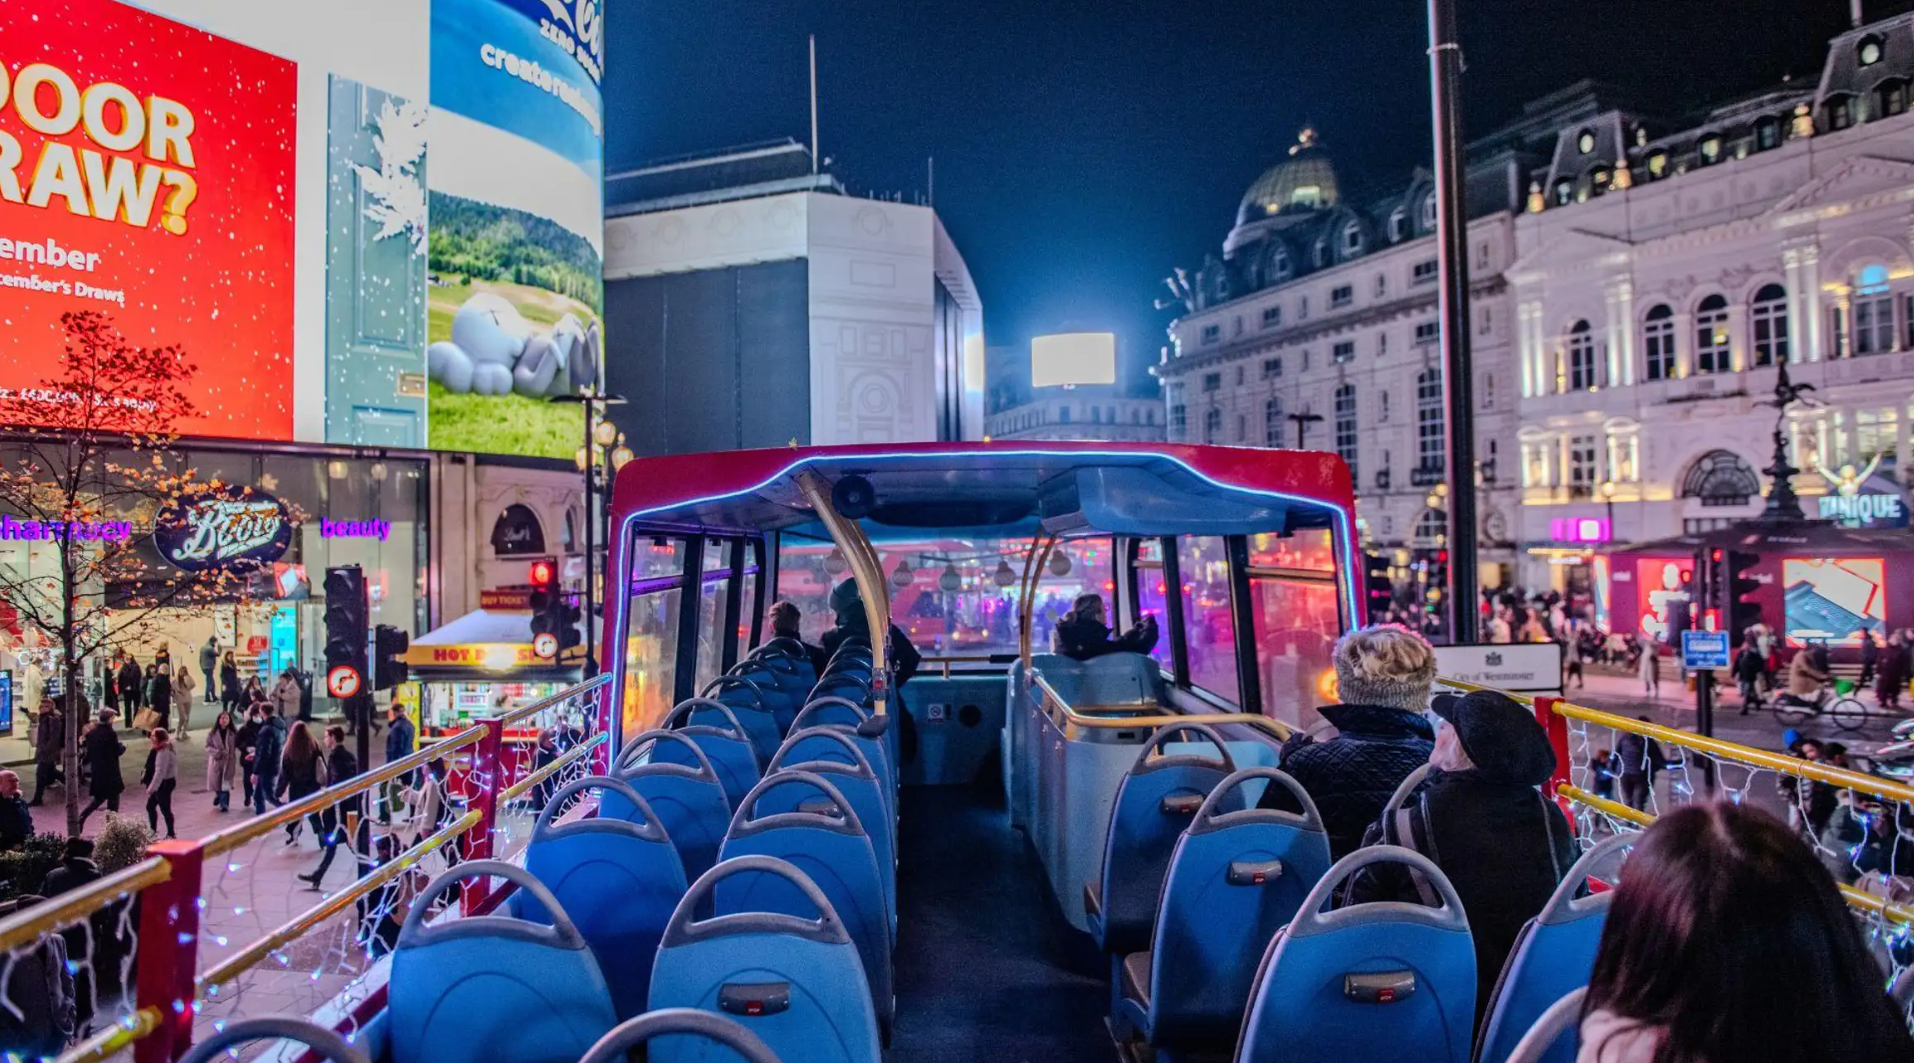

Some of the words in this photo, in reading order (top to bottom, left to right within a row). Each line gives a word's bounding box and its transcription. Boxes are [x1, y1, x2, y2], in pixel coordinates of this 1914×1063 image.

[0, 60, 197, 169] OOR
[0, 238, 102, 272] ember
[75, 281, 125, 303] Draws
[0, 514, 132, 546] harmacy
[171, 499, 280, 561] Boots
[320, 515, 391, 541] beauty
[433, 648, 471, 662] HOT
[1482, 671, 1535, 682] Westminster
